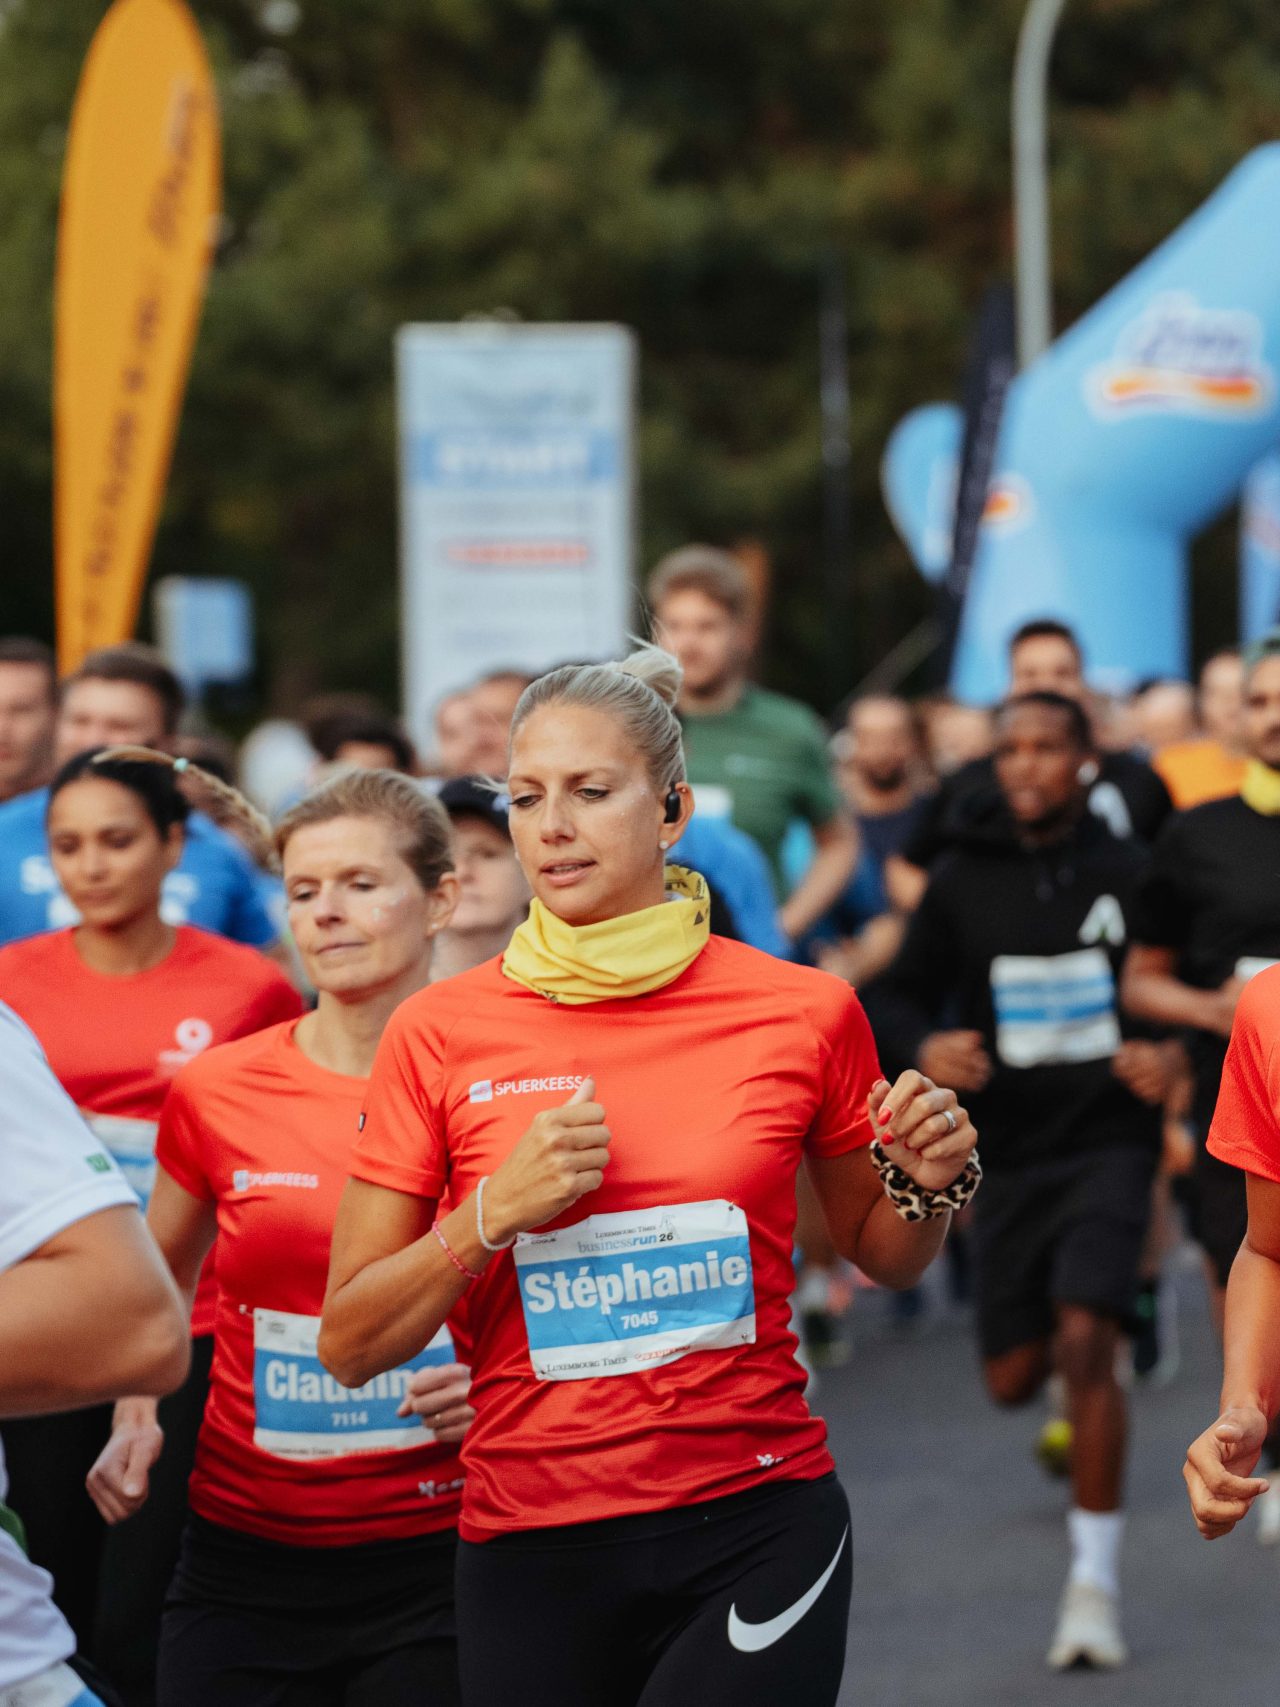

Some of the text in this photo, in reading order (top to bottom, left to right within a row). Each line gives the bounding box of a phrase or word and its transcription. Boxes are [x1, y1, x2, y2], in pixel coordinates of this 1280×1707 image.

[659, 1232, 674, 1242] 26
[524, 1250, 748, 1315] Stéphanie
[620, 1310, 659, 1330] 7045
[331, 1411, 368, 1427] 7114
